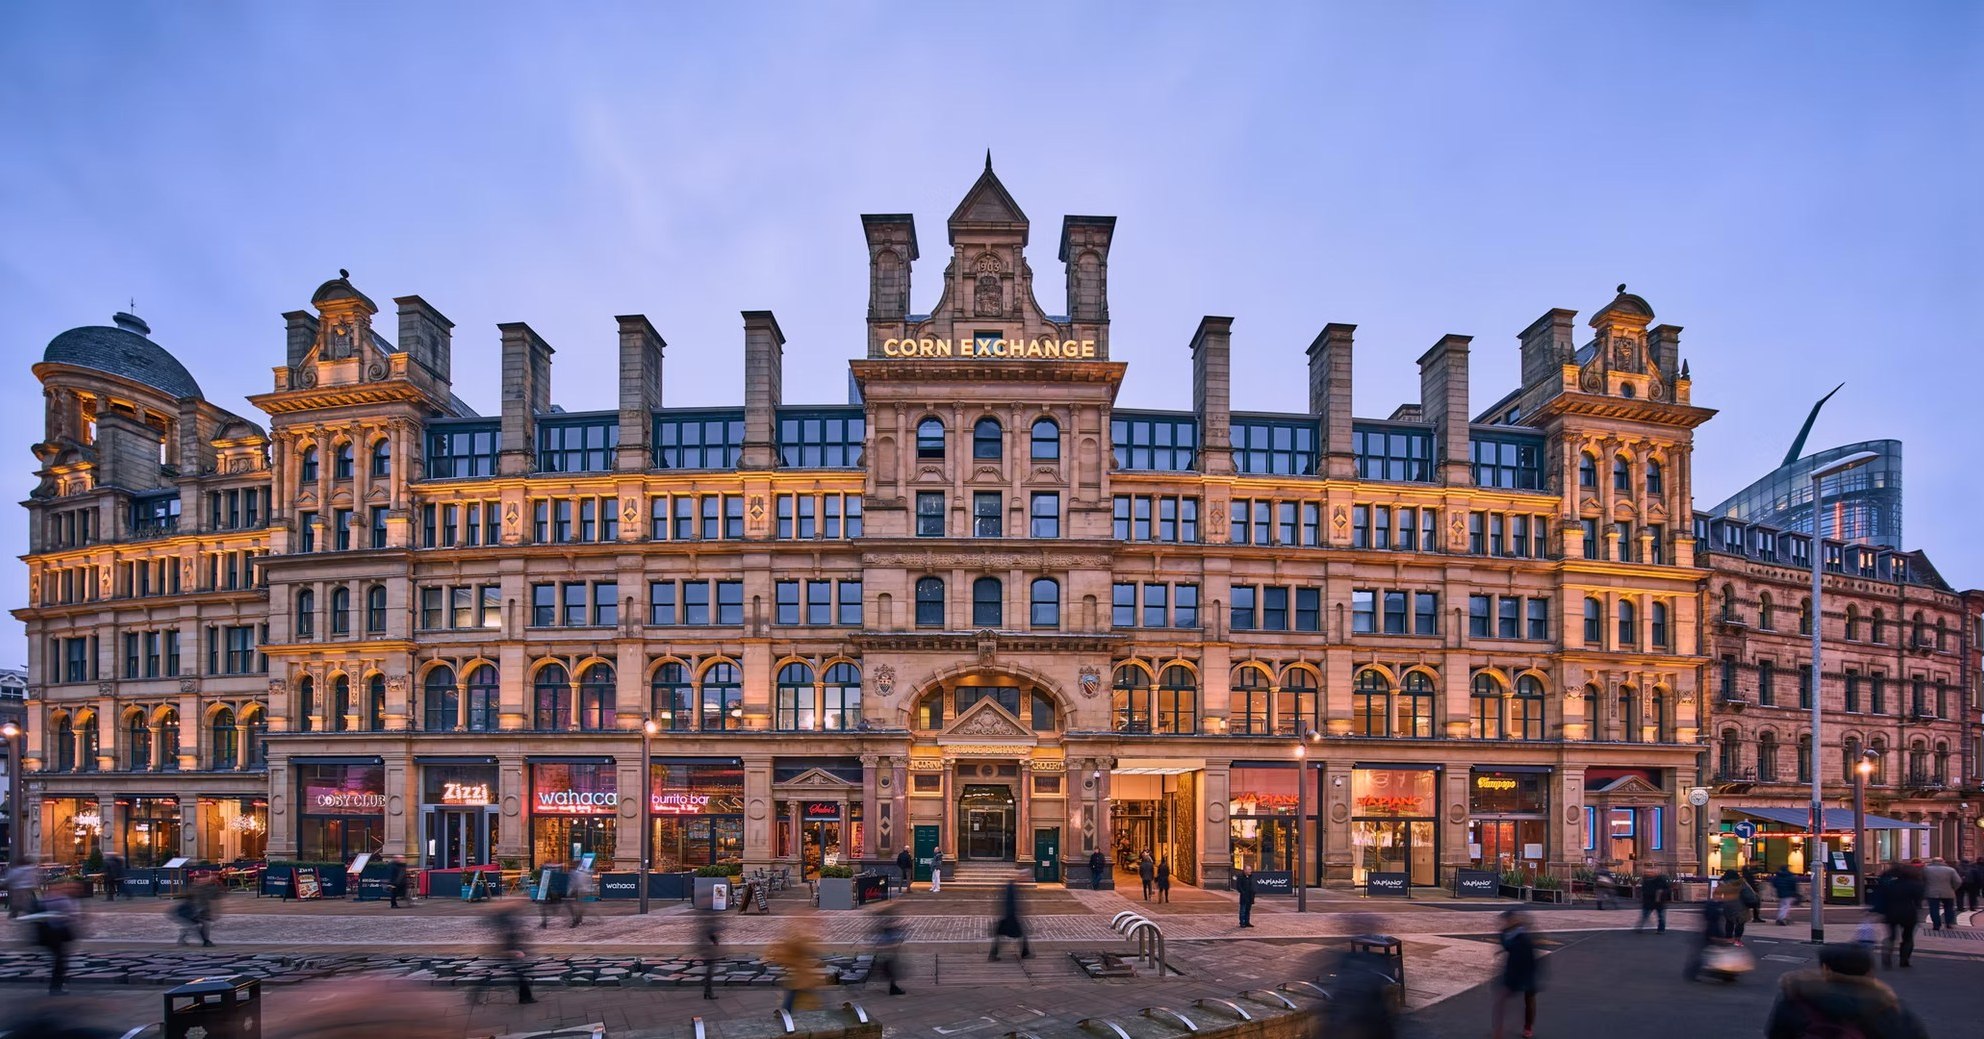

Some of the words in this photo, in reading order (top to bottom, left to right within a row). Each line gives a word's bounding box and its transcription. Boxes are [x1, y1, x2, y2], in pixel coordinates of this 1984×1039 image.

[977, 259, 1000, 272] 1903
[883, 338, 951, 356] CORN
[960, 339, 1095, 357] EXCHANGE
[986, 745, 1027, 754] EXCHANGE
[441, 783, 488, 800] Zizzi
[538, 789, 617, 805] wahaca
[317, 794, 350, 807] COSY
[353, 794, 387, 807] CLUB
[651, 793, 687, 805] burrito
[690, 793, 710, 804] bar
